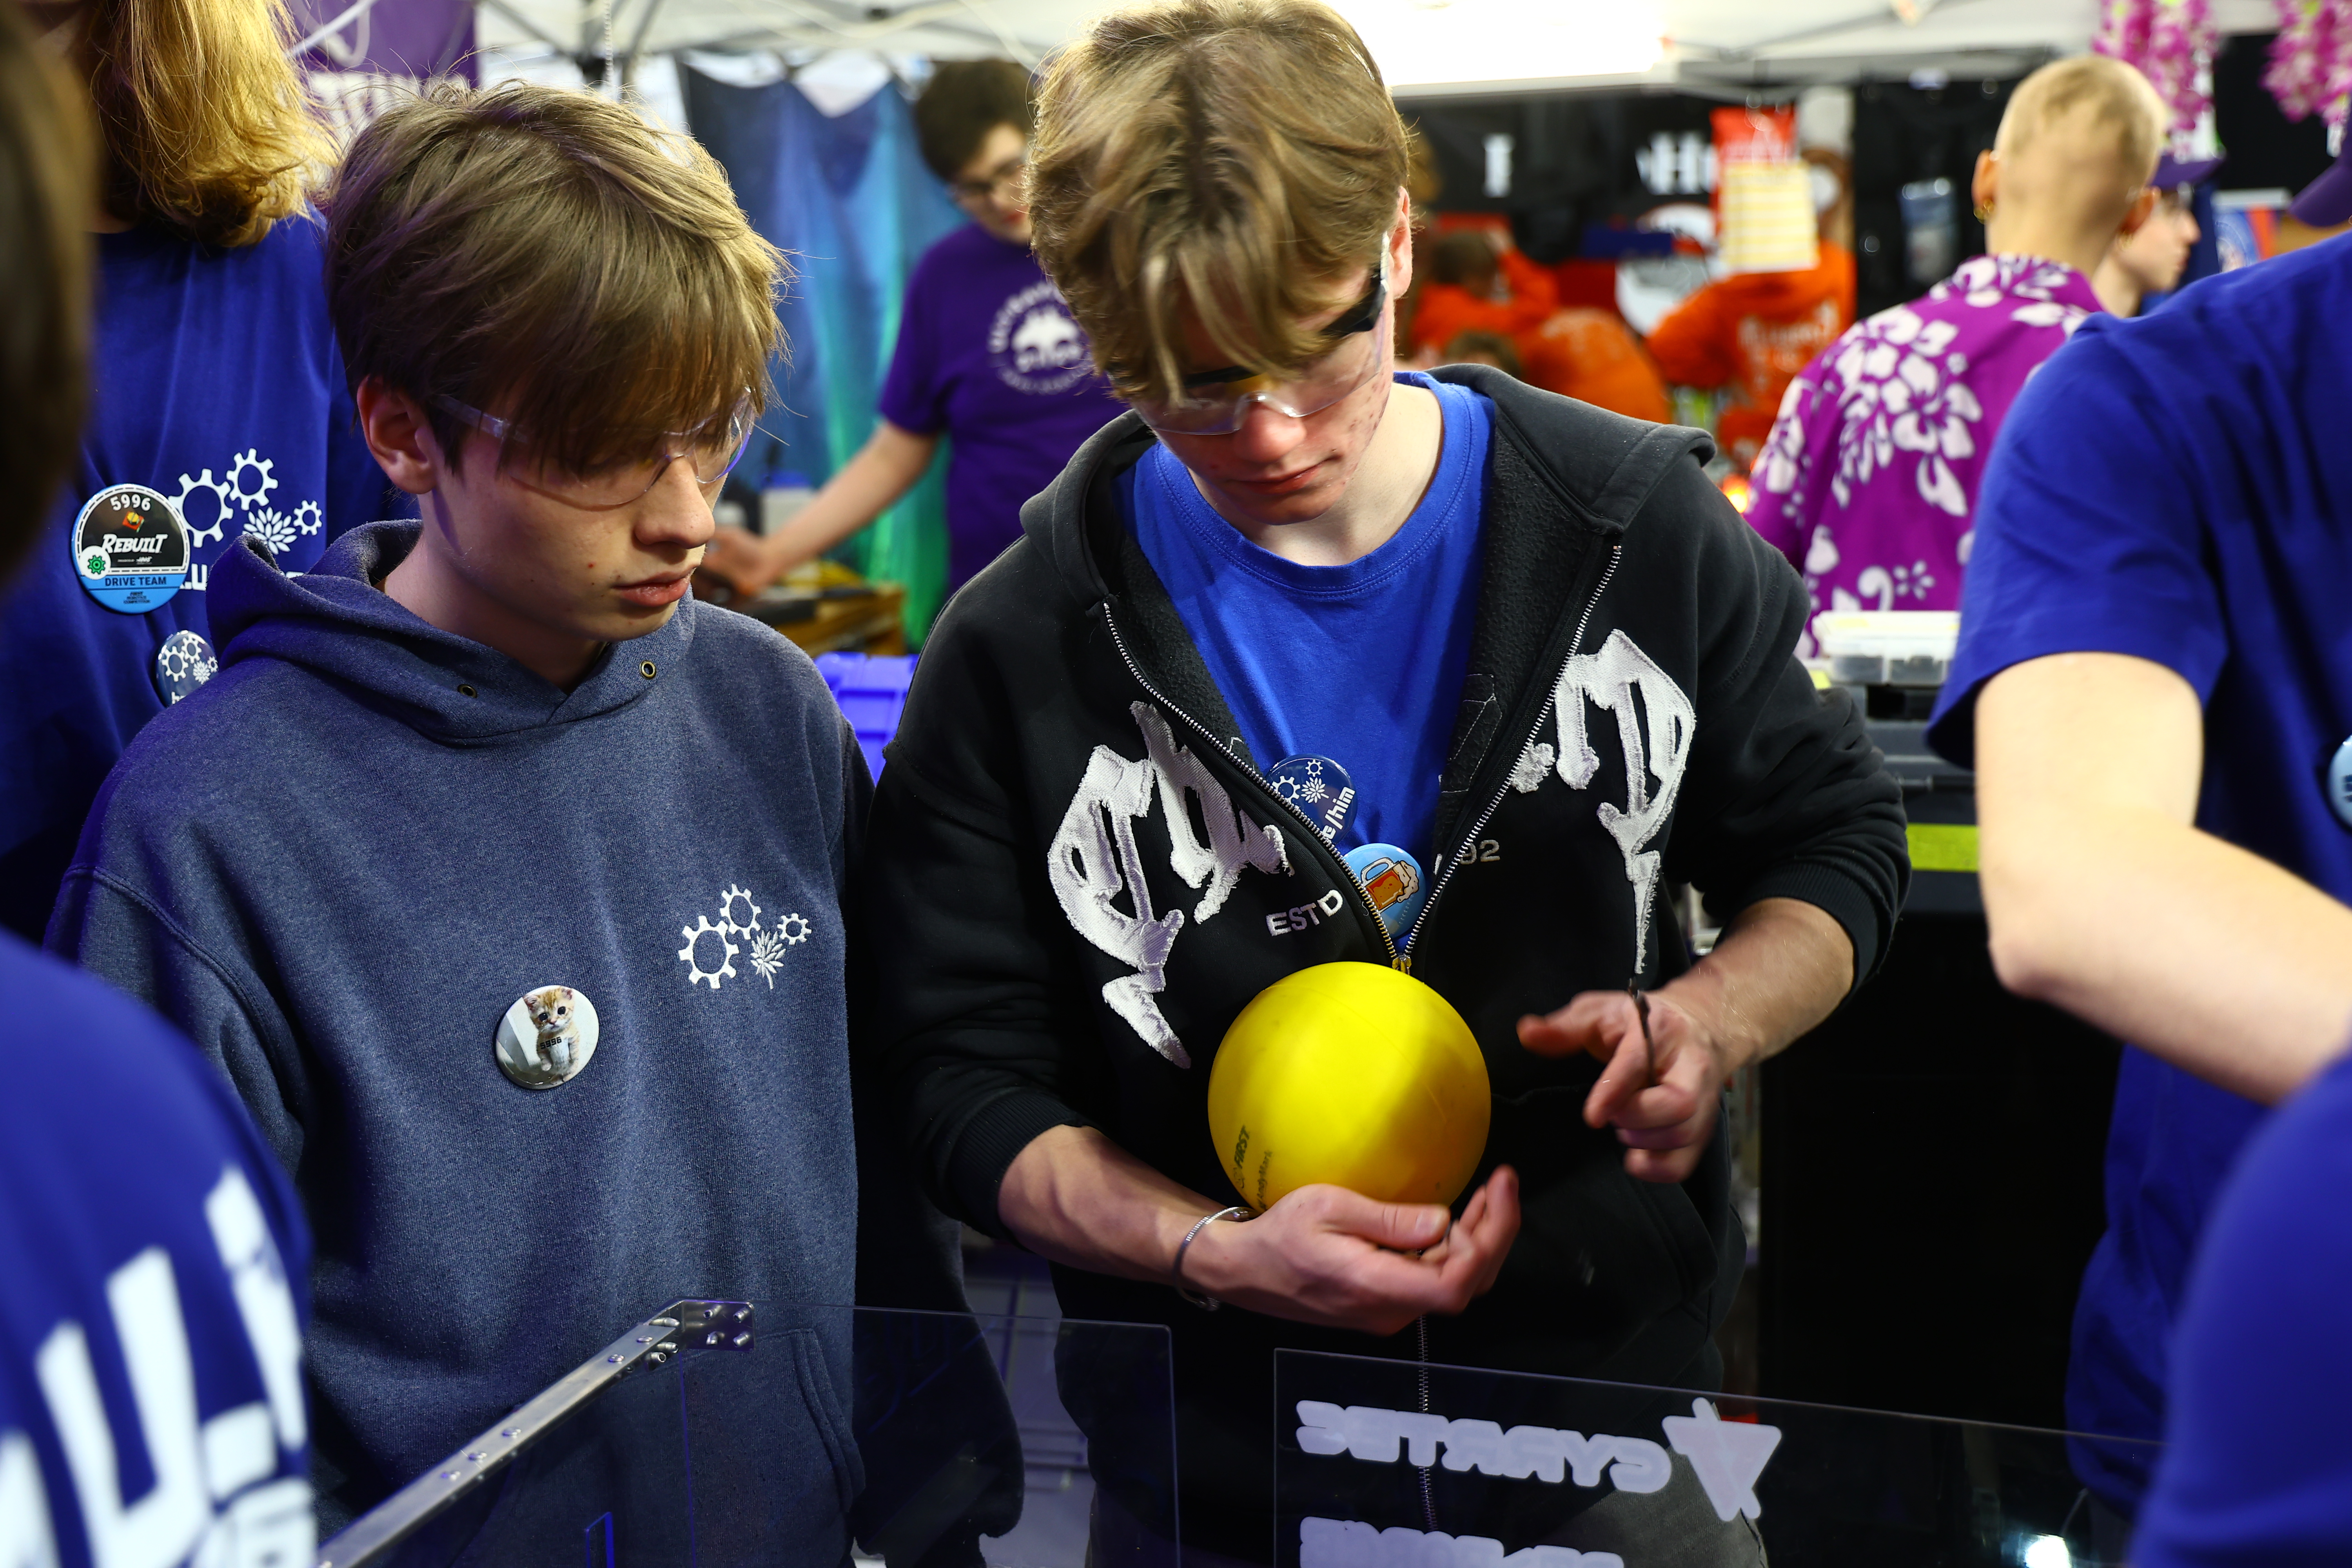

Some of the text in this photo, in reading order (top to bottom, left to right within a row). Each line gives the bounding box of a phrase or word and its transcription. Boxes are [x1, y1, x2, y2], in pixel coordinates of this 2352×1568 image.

[110, 494, 151, 511] 5996
[102, 534, 169, 554] REBUILT
[105, 576, 167, 586] DRIVE TEAM
[1322, 786, 1356, 840] e/him
[1266, 889, 1343, 936] ESTD
[540, 1036, 562, 1049] 5996
[1234, 1125, 1250, 1169] FIRST
